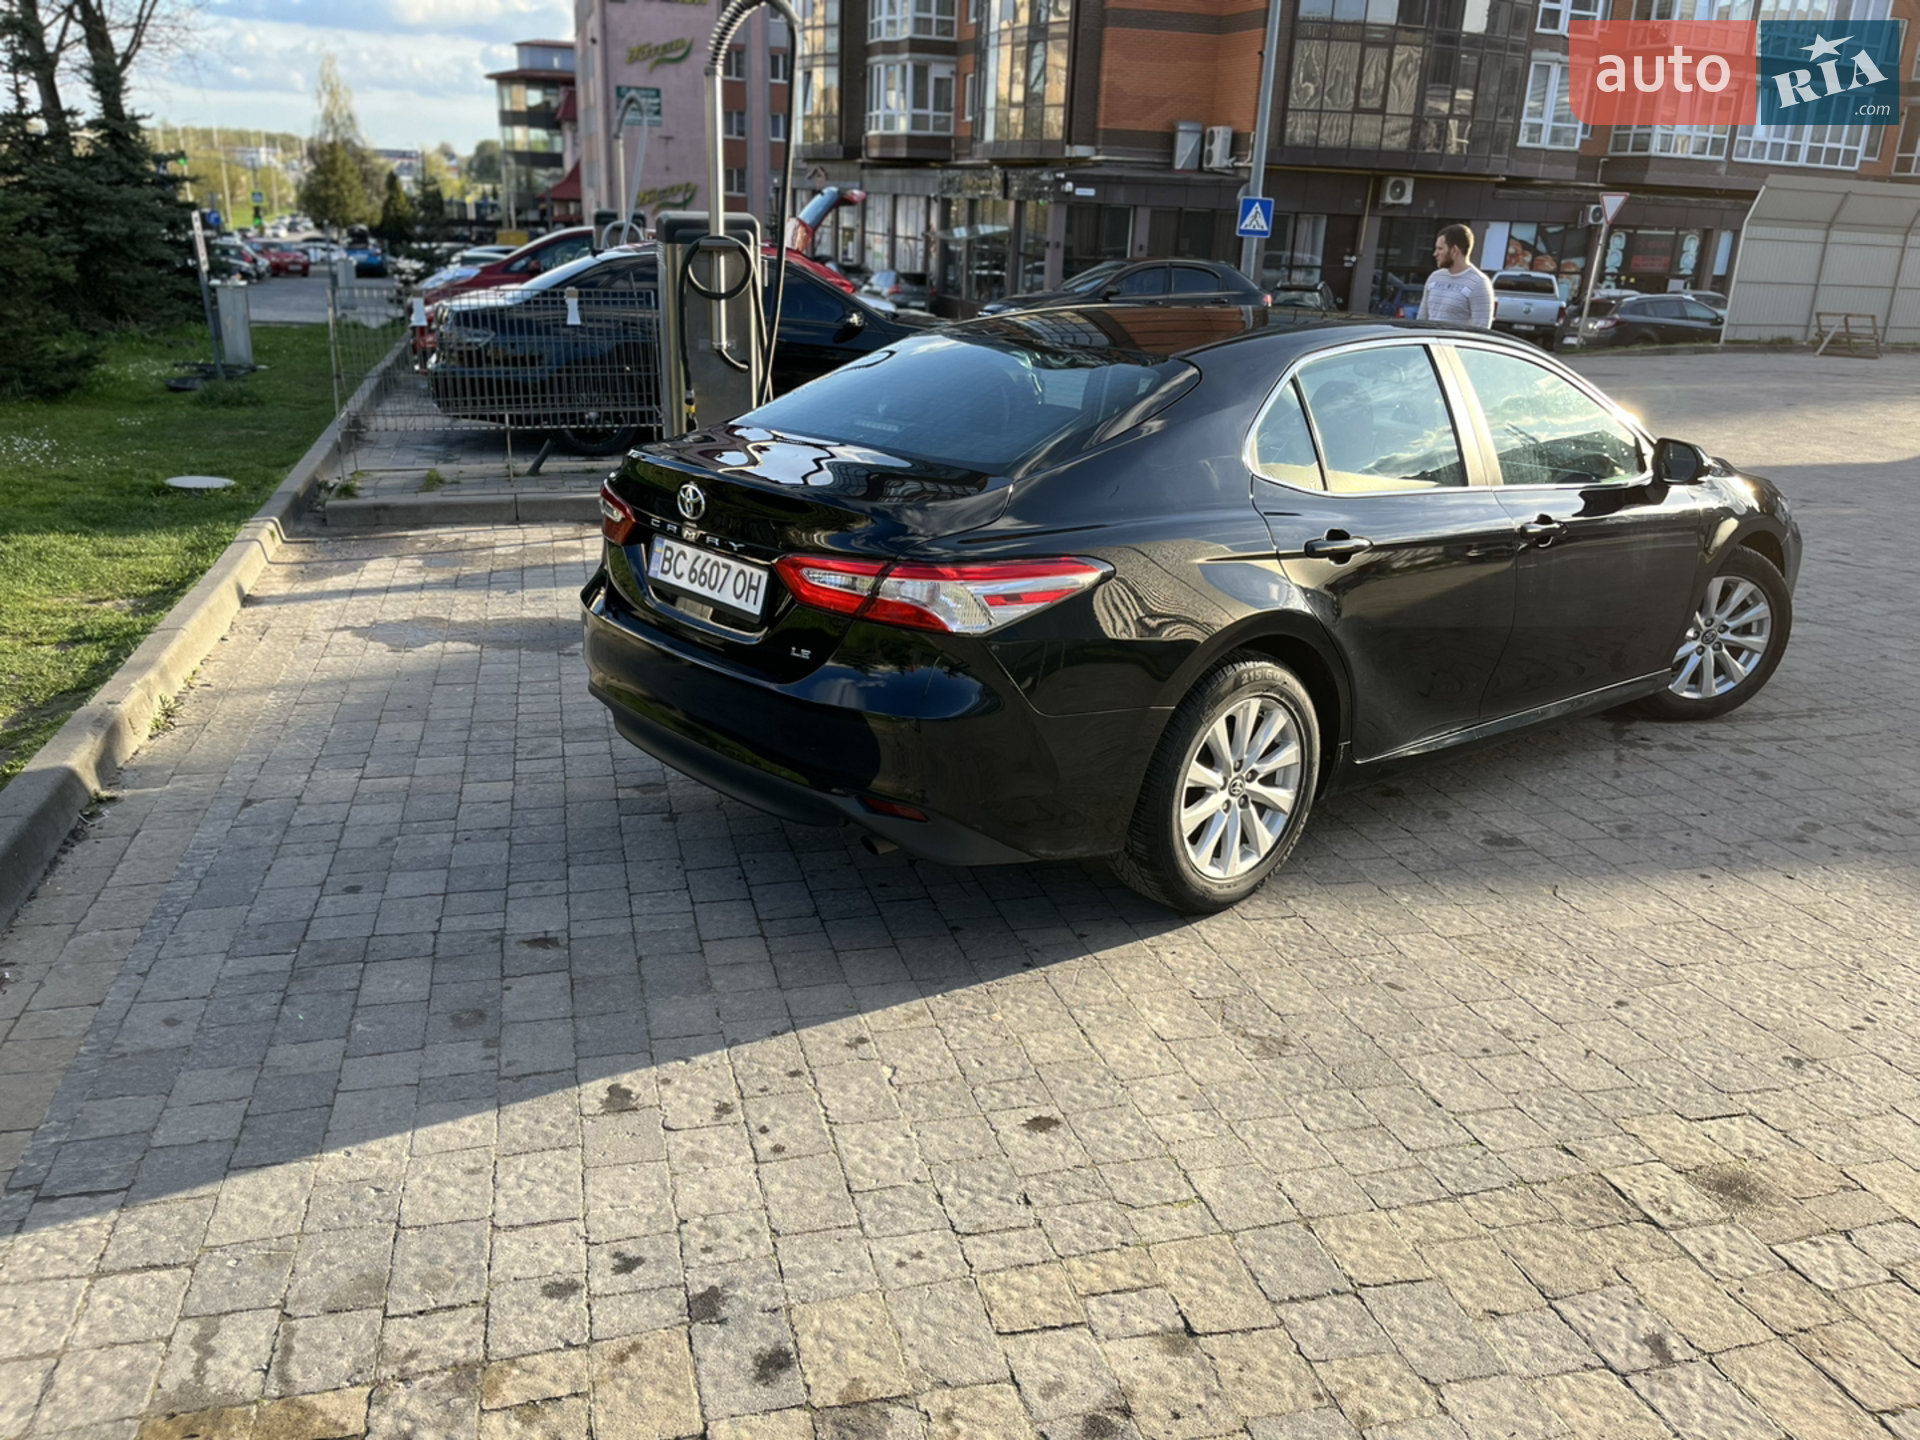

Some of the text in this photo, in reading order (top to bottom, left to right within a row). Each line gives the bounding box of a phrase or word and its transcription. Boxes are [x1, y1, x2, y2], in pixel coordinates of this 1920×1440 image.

[650, 518, 745, 551] CAMRY
[660, 546, 762, 606] BC 6607 OH
[790, 646, 812, 660] LE
